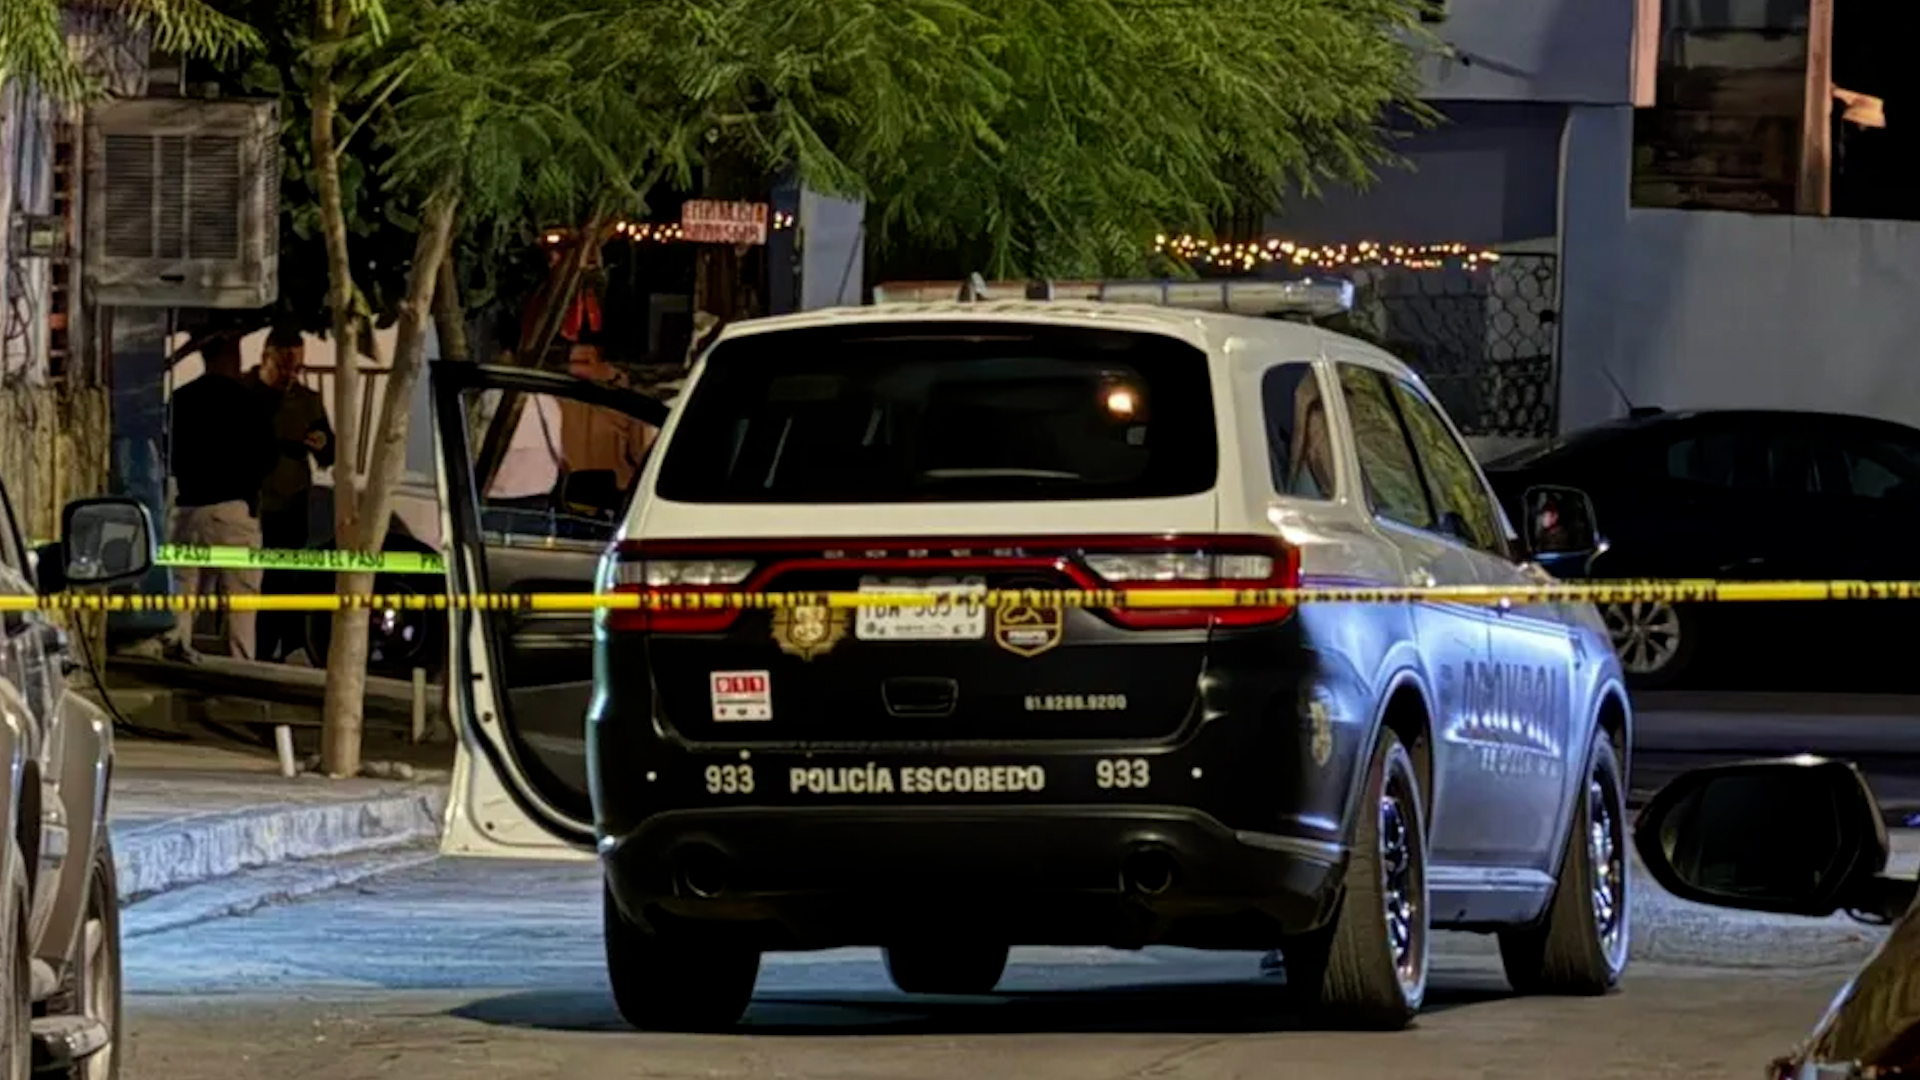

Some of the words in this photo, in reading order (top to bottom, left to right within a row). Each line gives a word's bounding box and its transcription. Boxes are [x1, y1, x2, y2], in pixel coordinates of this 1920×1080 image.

[348, 550, 385, 568] PASO
[705, 764, 755, 794] 933
[789, 761, 895, 794] POLICÍA
[900, 765, 1046, 794] ESCOBEDO
[1095, 758, 1150, 788] 933
